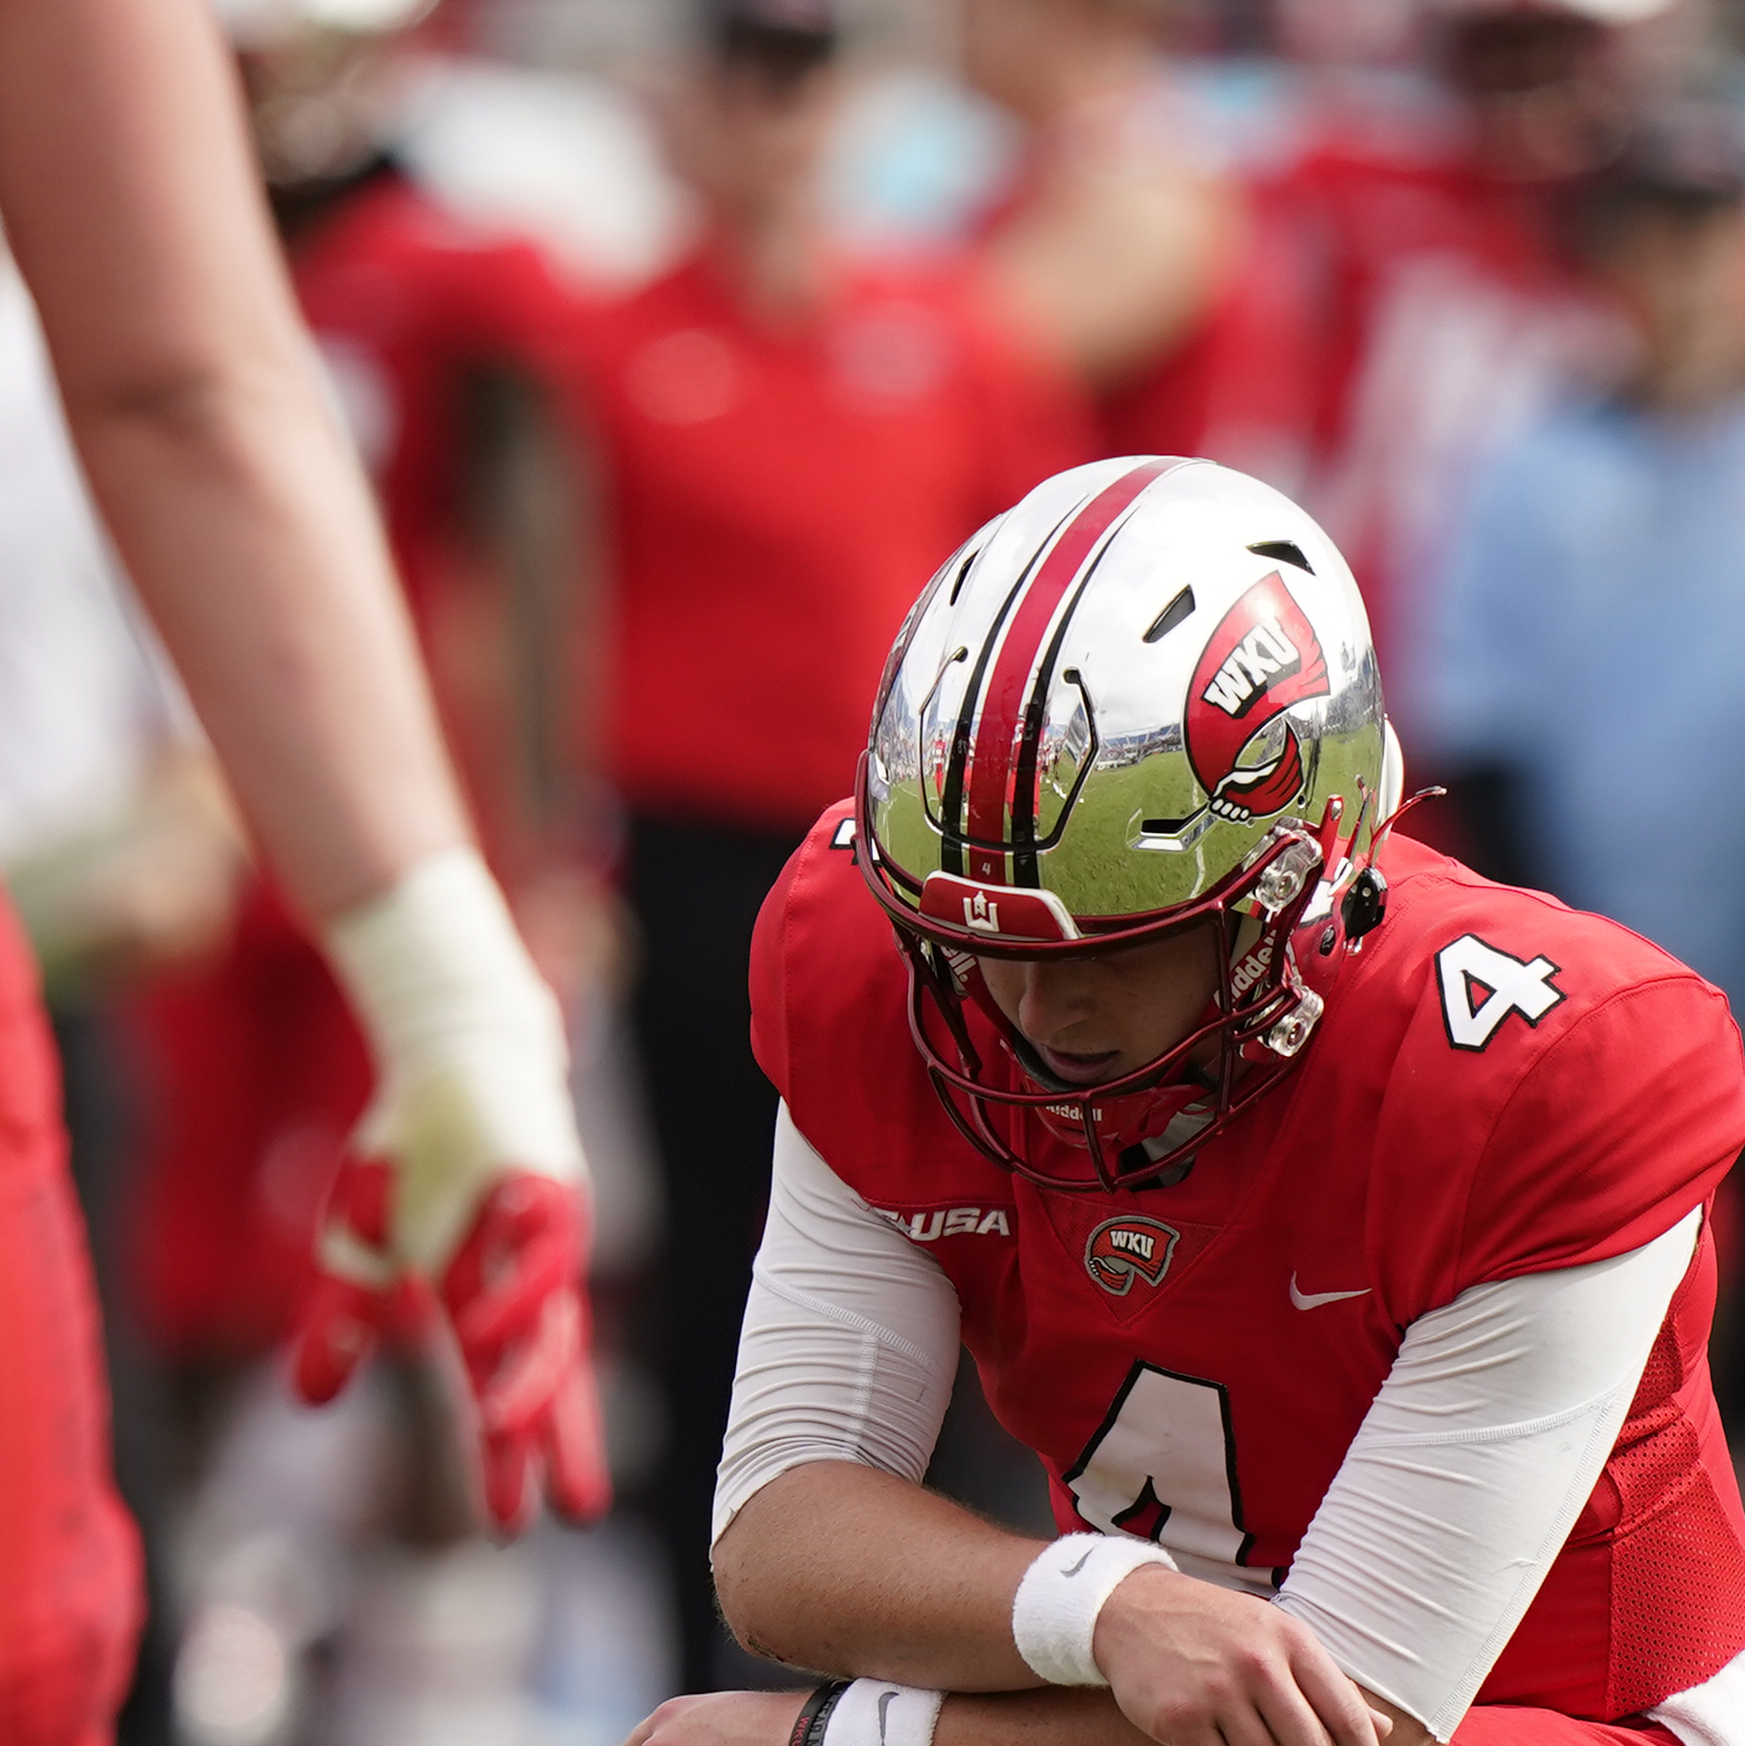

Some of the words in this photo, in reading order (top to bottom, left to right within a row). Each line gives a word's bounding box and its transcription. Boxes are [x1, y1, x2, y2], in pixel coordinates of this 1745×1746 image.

[1203, 615, 1299, 716] WKU
[981, 862, 992, 876] 4
[1434, 932, 1568, 1053] 4
[1110, 1230, 1155, 1259] WKU
[1062, 1359, 1284, 1601] 4
